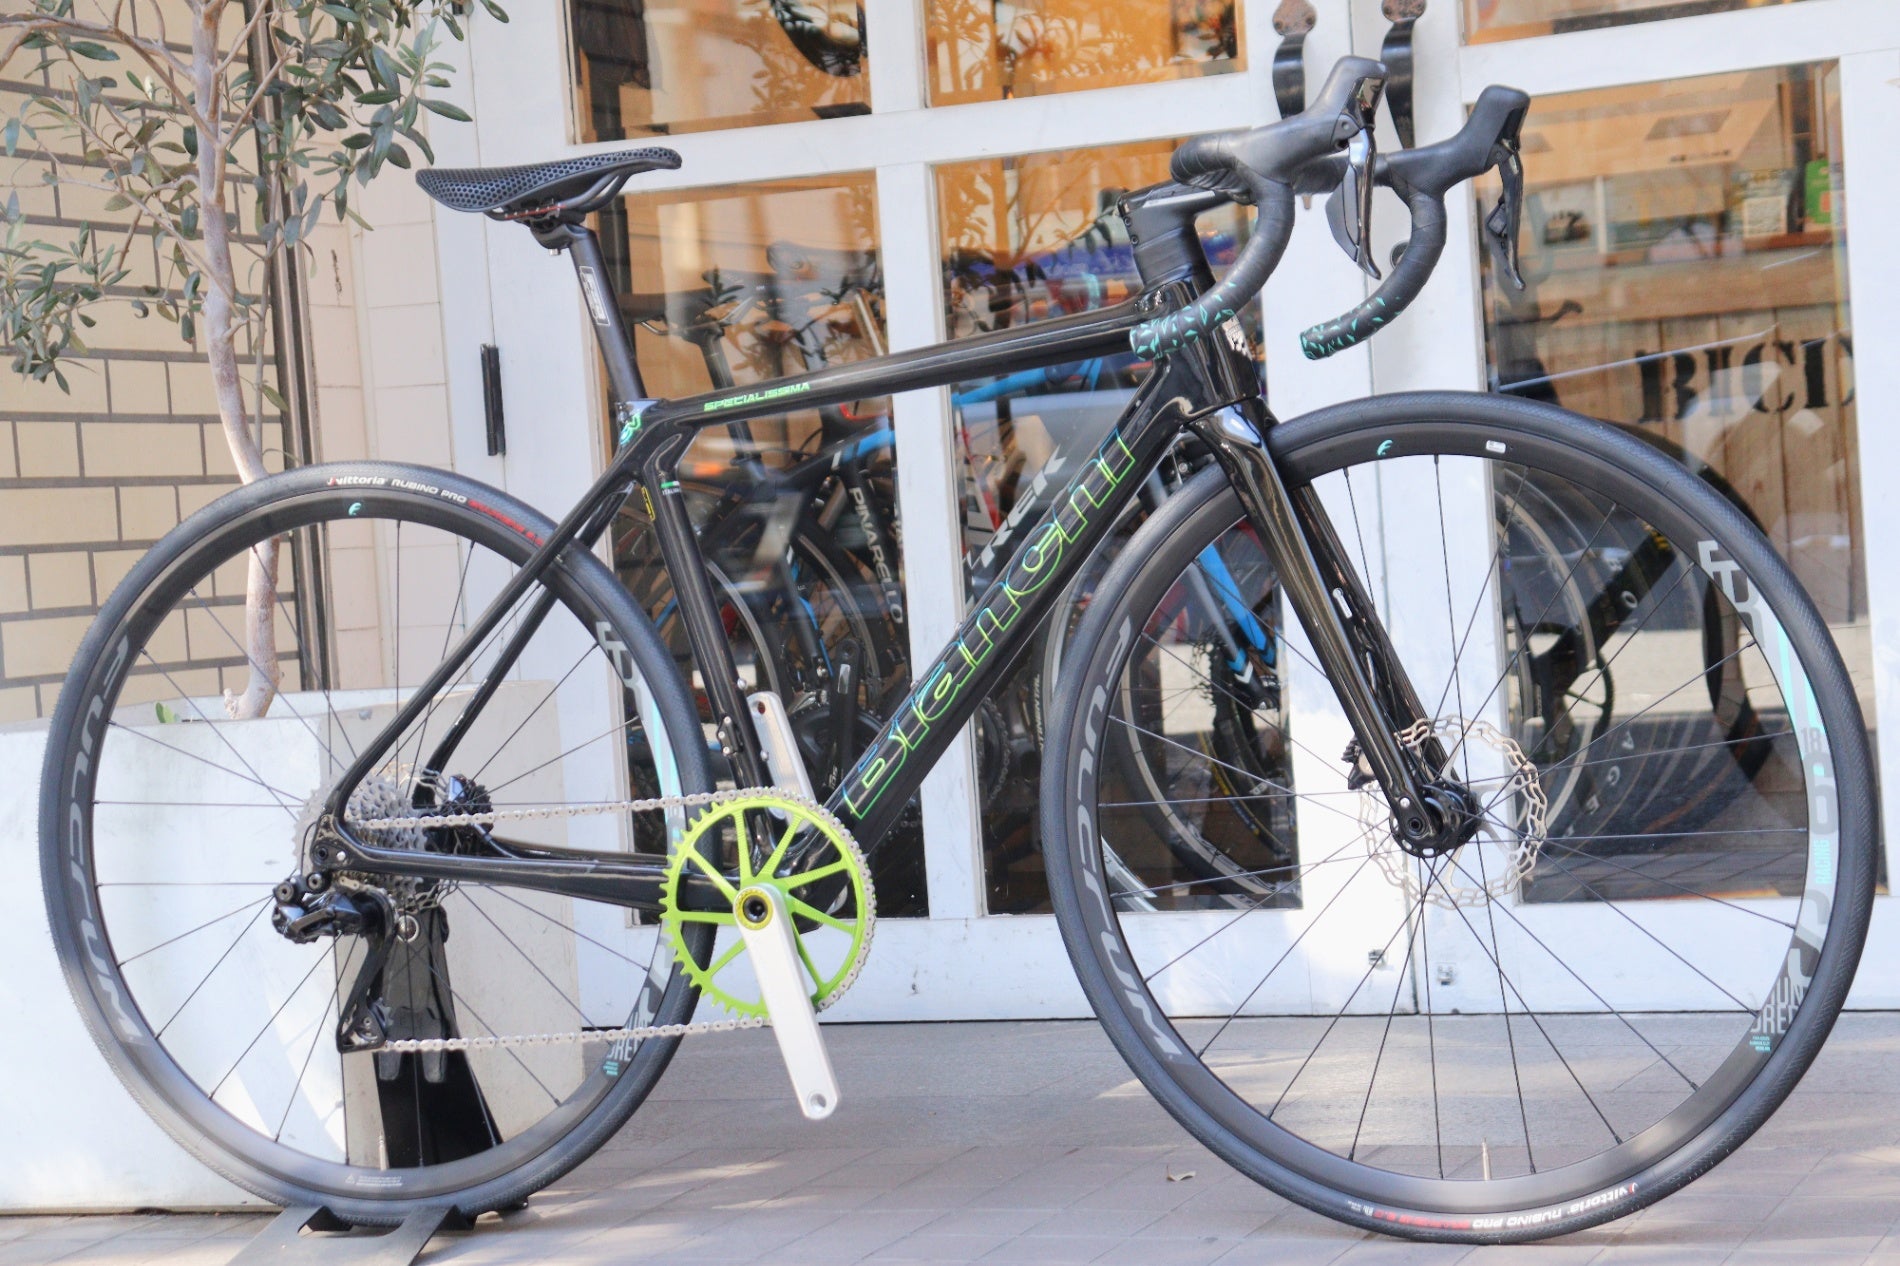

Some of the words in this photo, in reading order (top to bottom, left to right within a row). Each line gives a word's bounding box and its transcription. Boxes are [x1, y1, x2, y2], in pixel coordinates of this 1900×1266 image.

[704, 382, 811, 412] SPECIALISSIMA
[335, 475, 386, 487] vittoria
[391, 478, 439, 495] RUBINO
[440, 489, 467, 504] PRO
[849, 486, 904, 624] PINARELLO
[1575, 1186, 1629, 1214] vittoria
